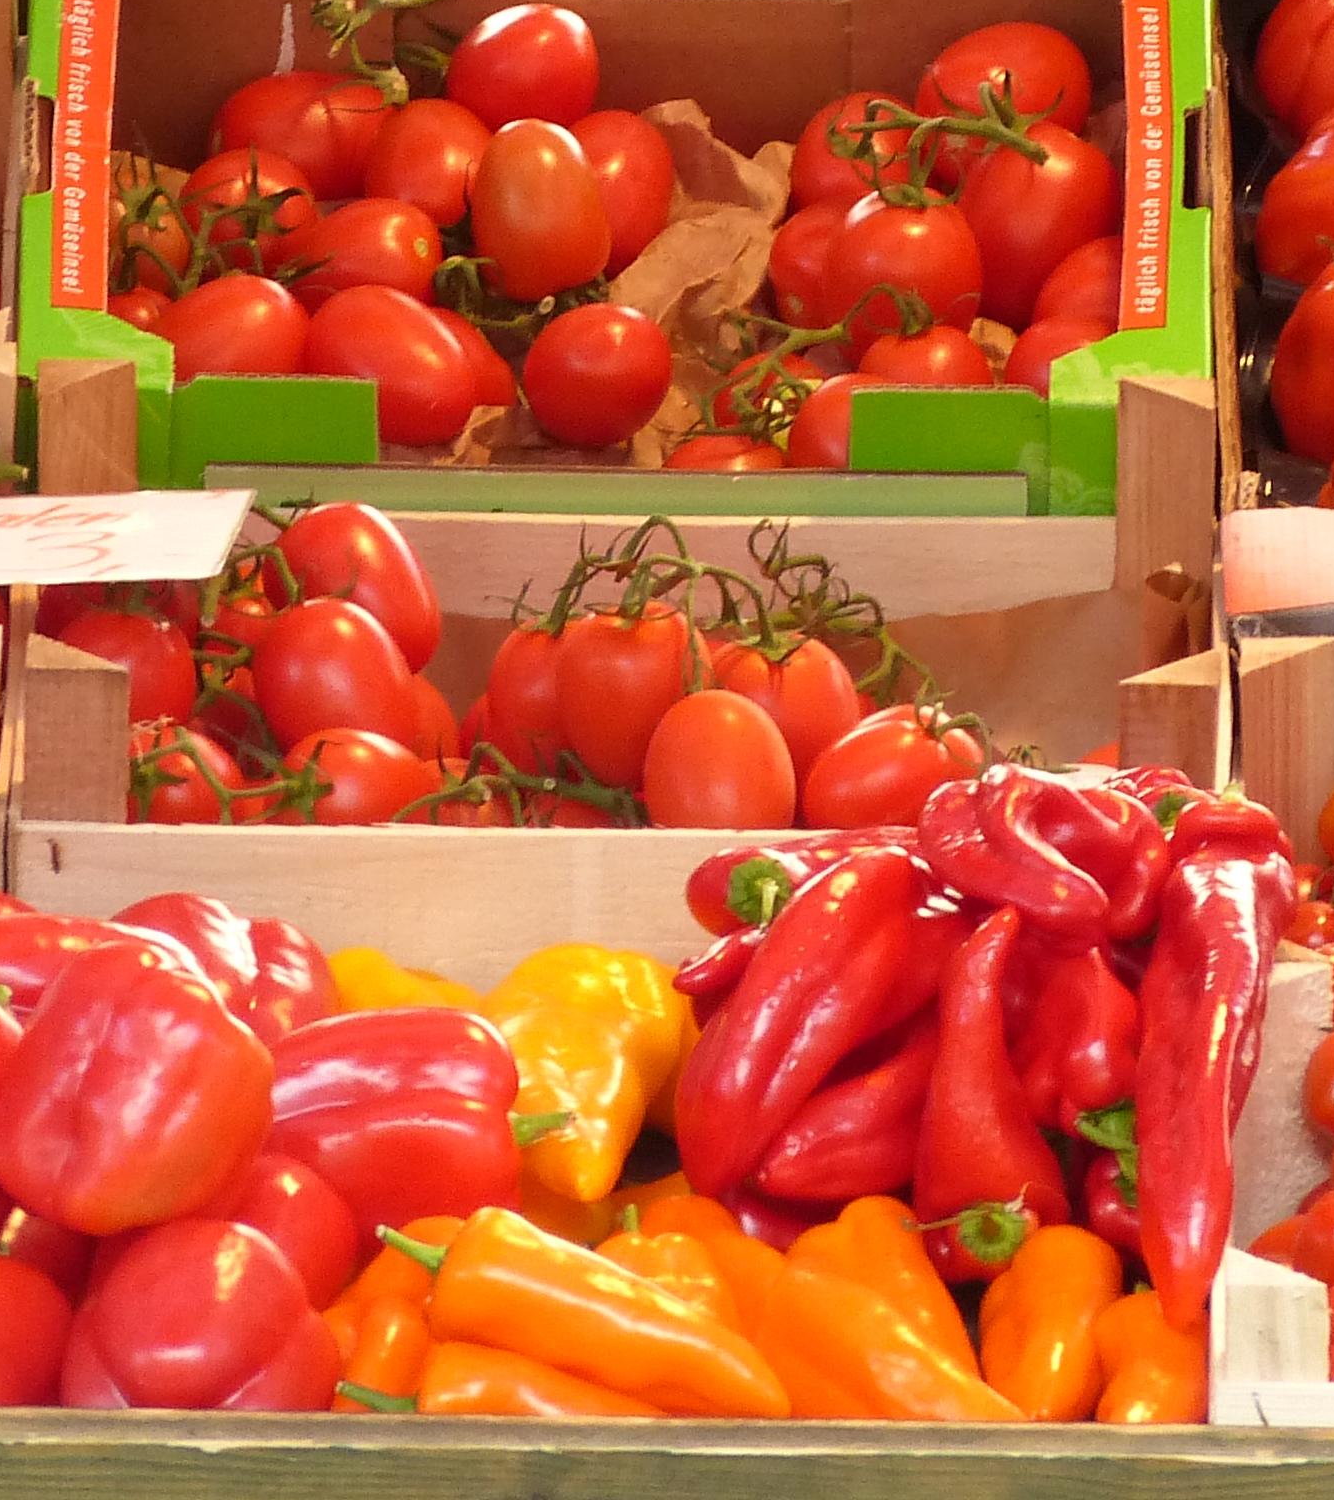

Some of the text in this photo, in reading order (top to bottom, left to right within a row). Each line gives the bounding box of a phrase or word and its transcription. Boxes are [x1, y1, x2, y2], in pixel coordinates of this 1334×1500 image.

[67, 61, 92, 113] frisch
[64, 119, 84, 148] von
[63, 150, 87, 182] der
[1134, 6, 1164, 315] täglich frisch von der Gemüseinsel
